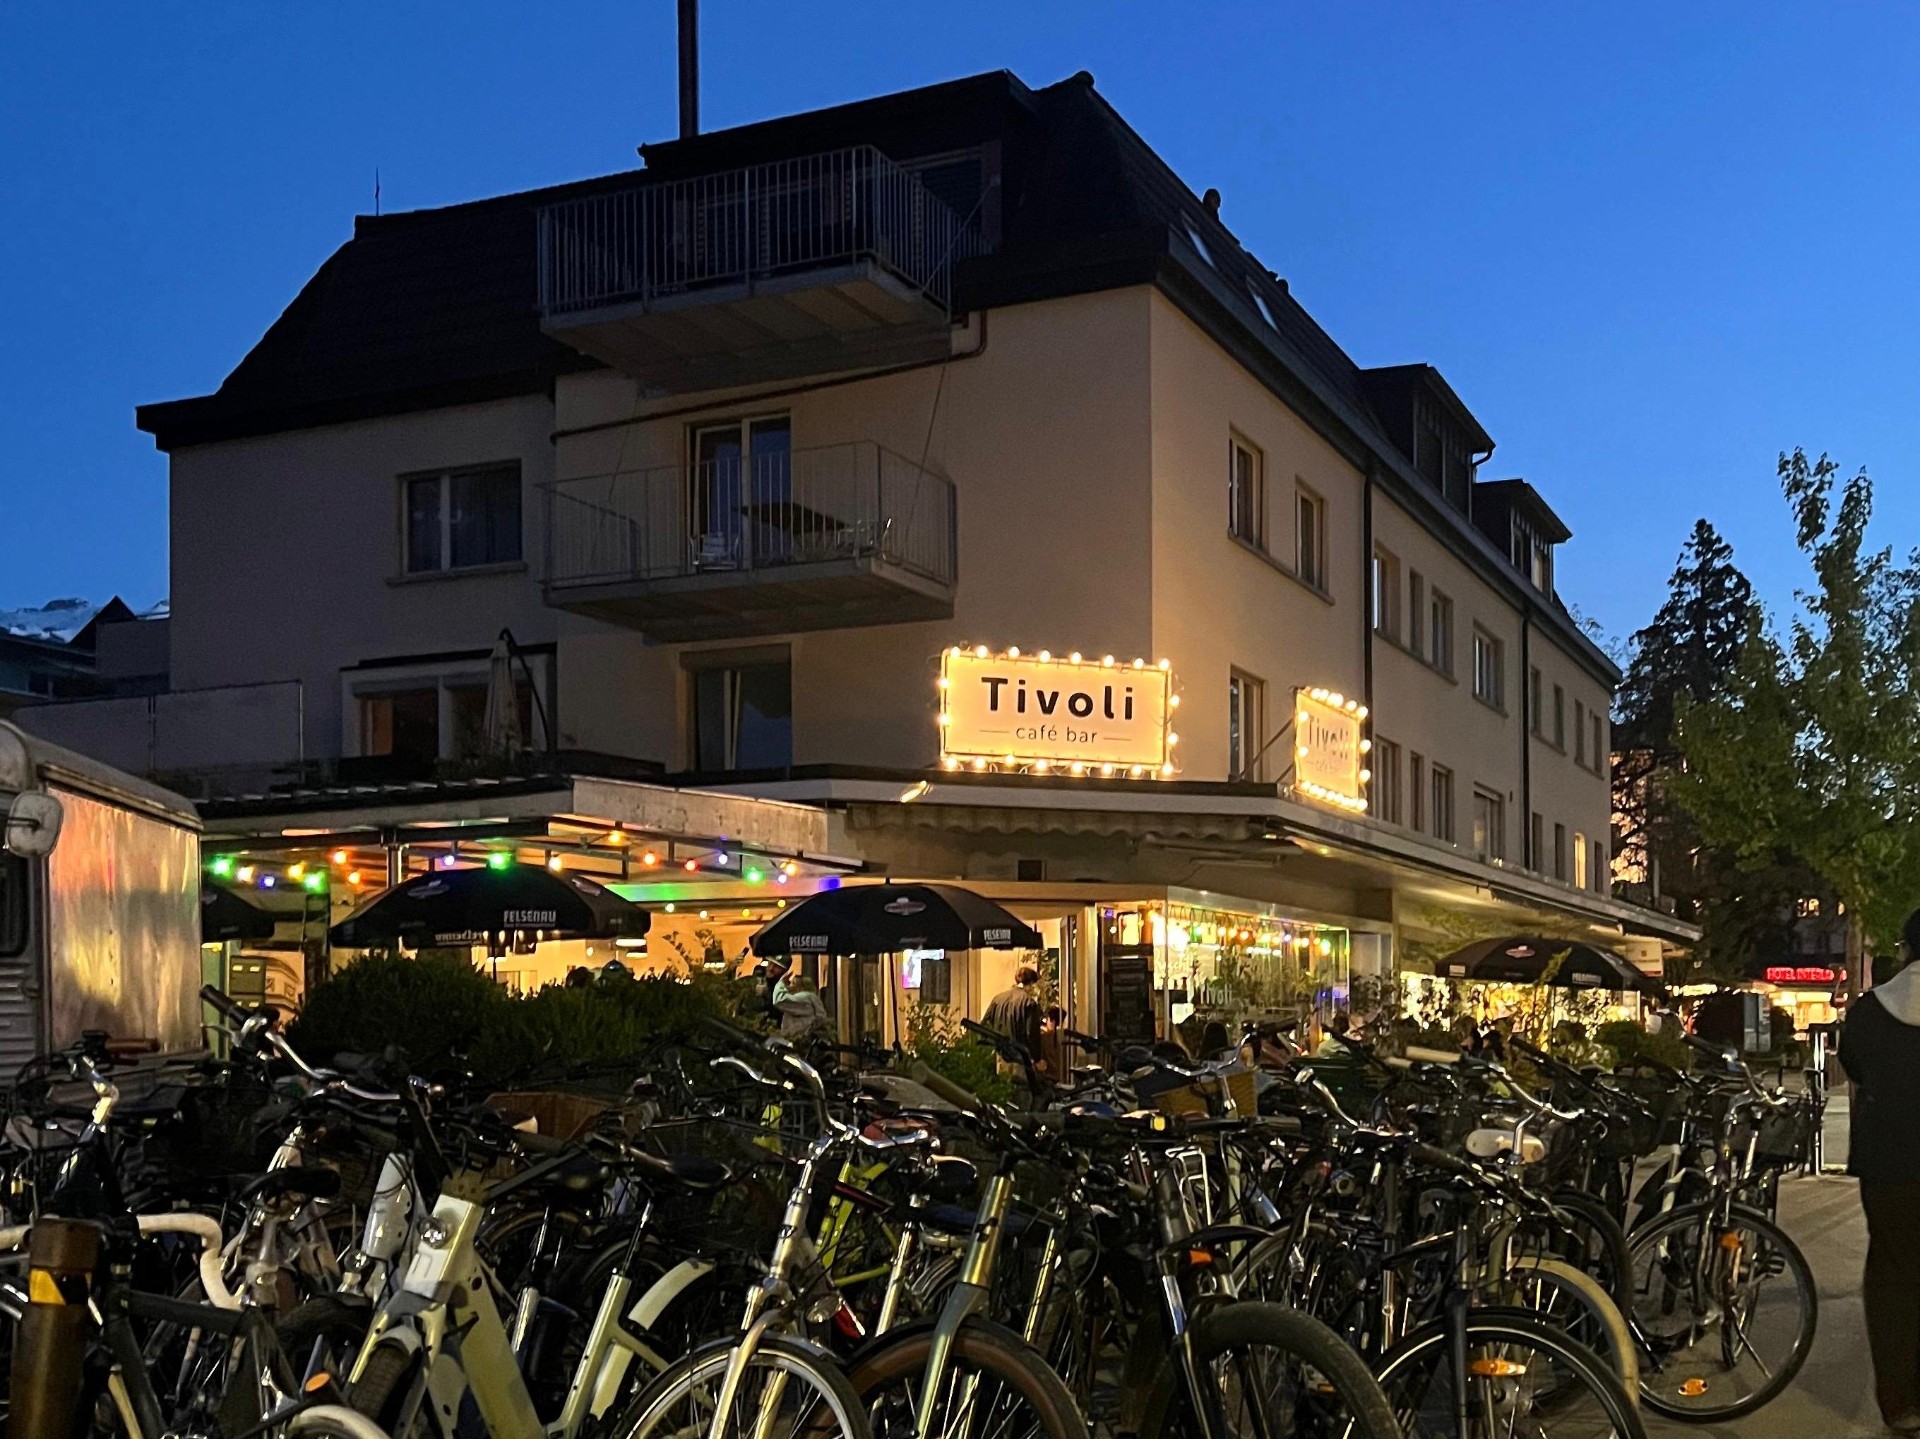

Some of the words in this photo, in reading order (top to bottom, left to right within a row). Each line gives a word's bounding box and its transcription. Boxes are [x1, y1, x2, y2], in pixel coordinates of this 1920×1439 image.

[980, 676, 1134, 721] Tivoli
[1015, 723, 1057, 743] café
[1066, 725, 1098, 744] bar
[503, 909, 557, 923] FELSENAU
[1766, 967, 1796, 980] HOTEL
